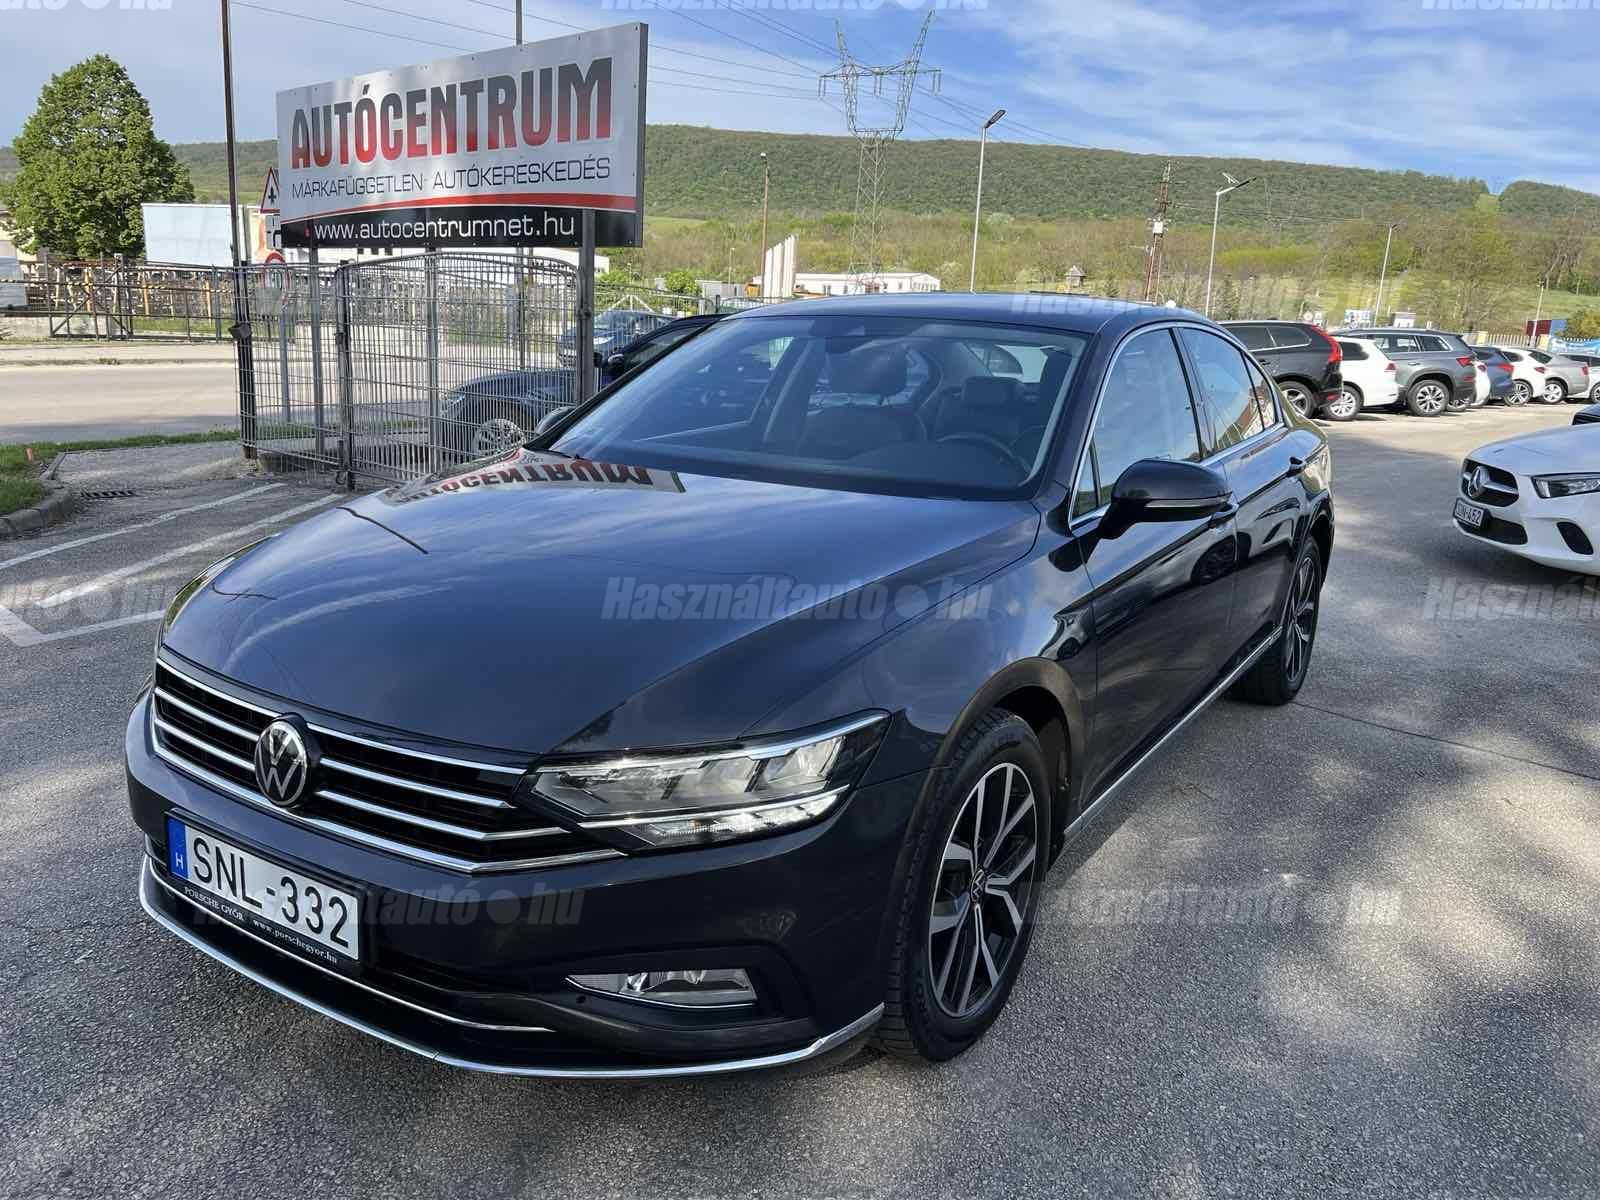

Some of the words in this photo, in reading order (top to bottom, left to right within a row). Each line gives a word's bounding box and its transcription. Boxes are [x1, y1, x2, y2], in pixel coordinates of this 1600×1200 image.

[291, 57, 613, 170] AUTÓCENTRUM
[292, 172, 423, 199] MÁRKAFÜGGETLEN
[433, 155, 611, 190] AUTÓKERESKEDÉS
[314, 211, 575, 240] www.autocentrumnet.hu
[175, 852, 184, 870] H
[193, 837, 350, 948] SNL-332
